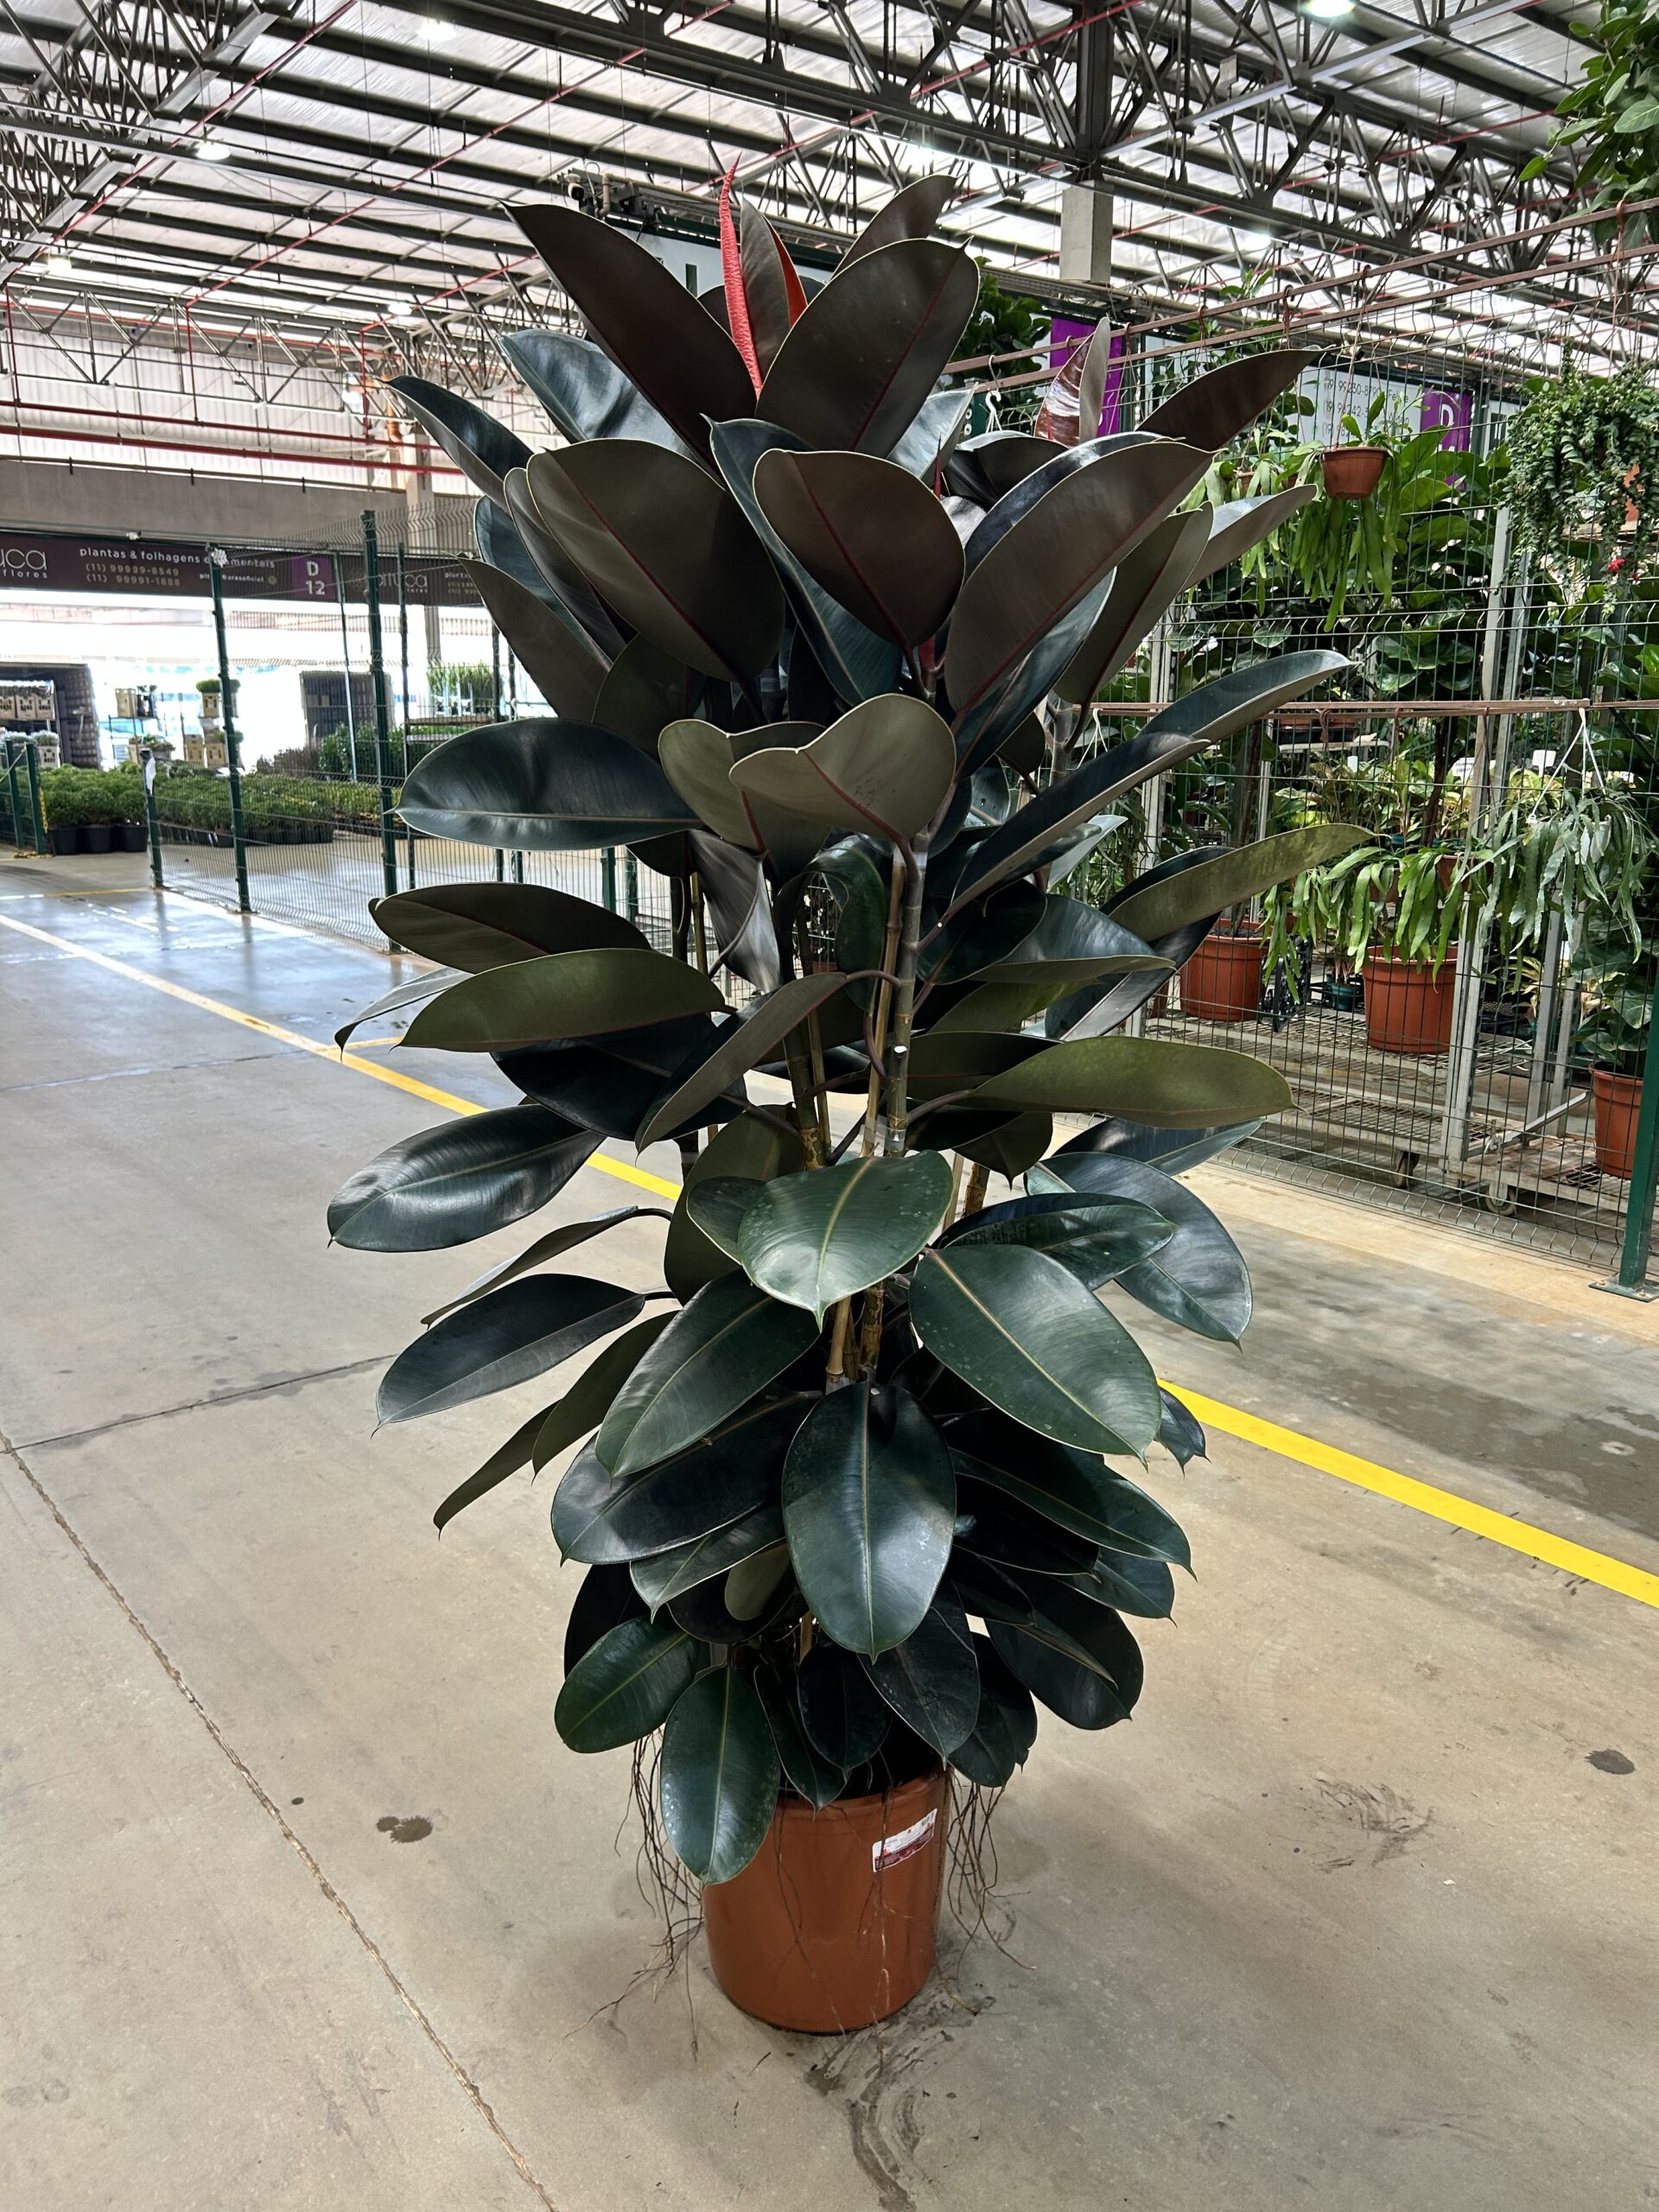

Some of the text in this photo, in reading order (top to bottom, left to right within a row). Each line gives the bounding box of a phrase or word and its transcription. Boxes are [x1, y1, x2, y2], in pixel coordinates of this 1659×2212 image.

[1439, 403, 1454, 427] D
[79, 547, 126, 559] plantas
[130, 550, 137, 559] &
[141, 550, 200, 563] folhagens
[3, 569, 48, 579] flores
[86, 563, 106, 572] (11)
[306, 561, 319, 576] D
[86, 574, 108, 583] (11)
[305, 580, 326, 595] 12
